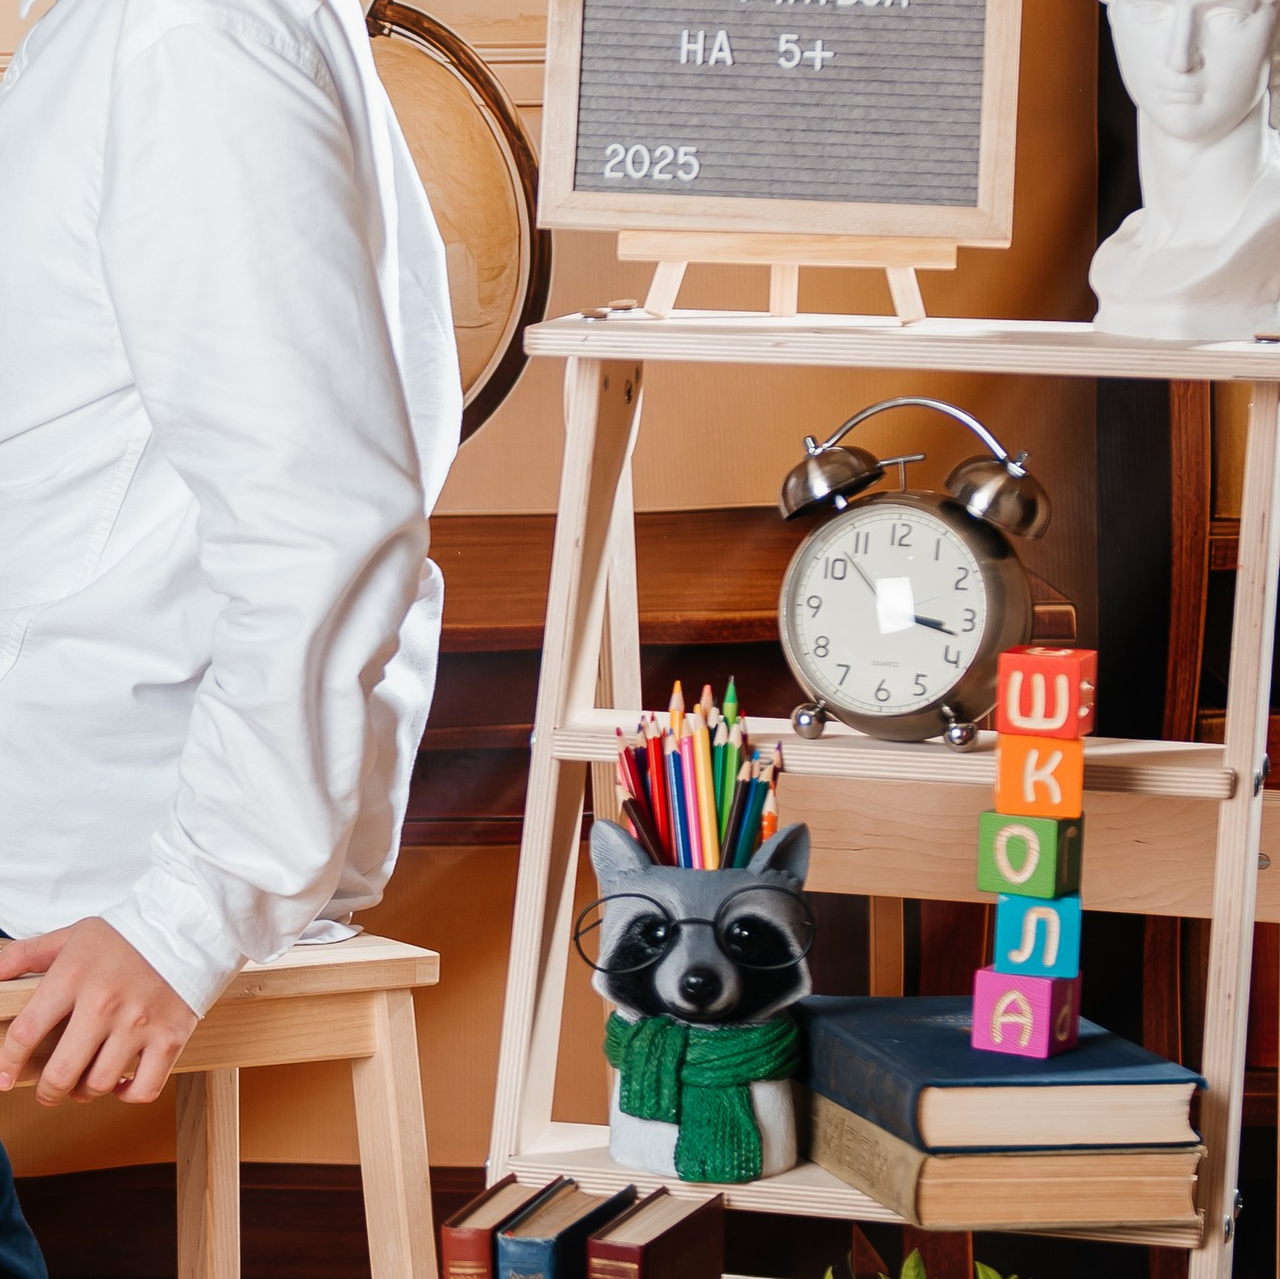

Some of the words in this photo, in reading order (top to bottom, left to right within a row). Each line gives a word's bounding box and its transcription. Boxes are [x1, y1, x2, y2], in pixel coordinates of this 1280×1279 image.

[679, 28, 735, 67] НА
[777, 33, 836, 72] 5+
[603, 143, 701, 182] 2025
[854, 530, 870, 555] 11
[890, 524, 913, 547] 12
[933, 537, 942, 561] 1
[823, 556, 848, 580] 10
[953, 567, 970, 591] 2
[806, 594, 823, 619] 9
[961, 608, 977, 633] 3
[813, 636, 830, 659] 8
[944, 645, 962, 668] 4
[836, 664, 852, 686] 7
[912, 674, 928, 696] 5
[874, 678, 892, 702] 6
